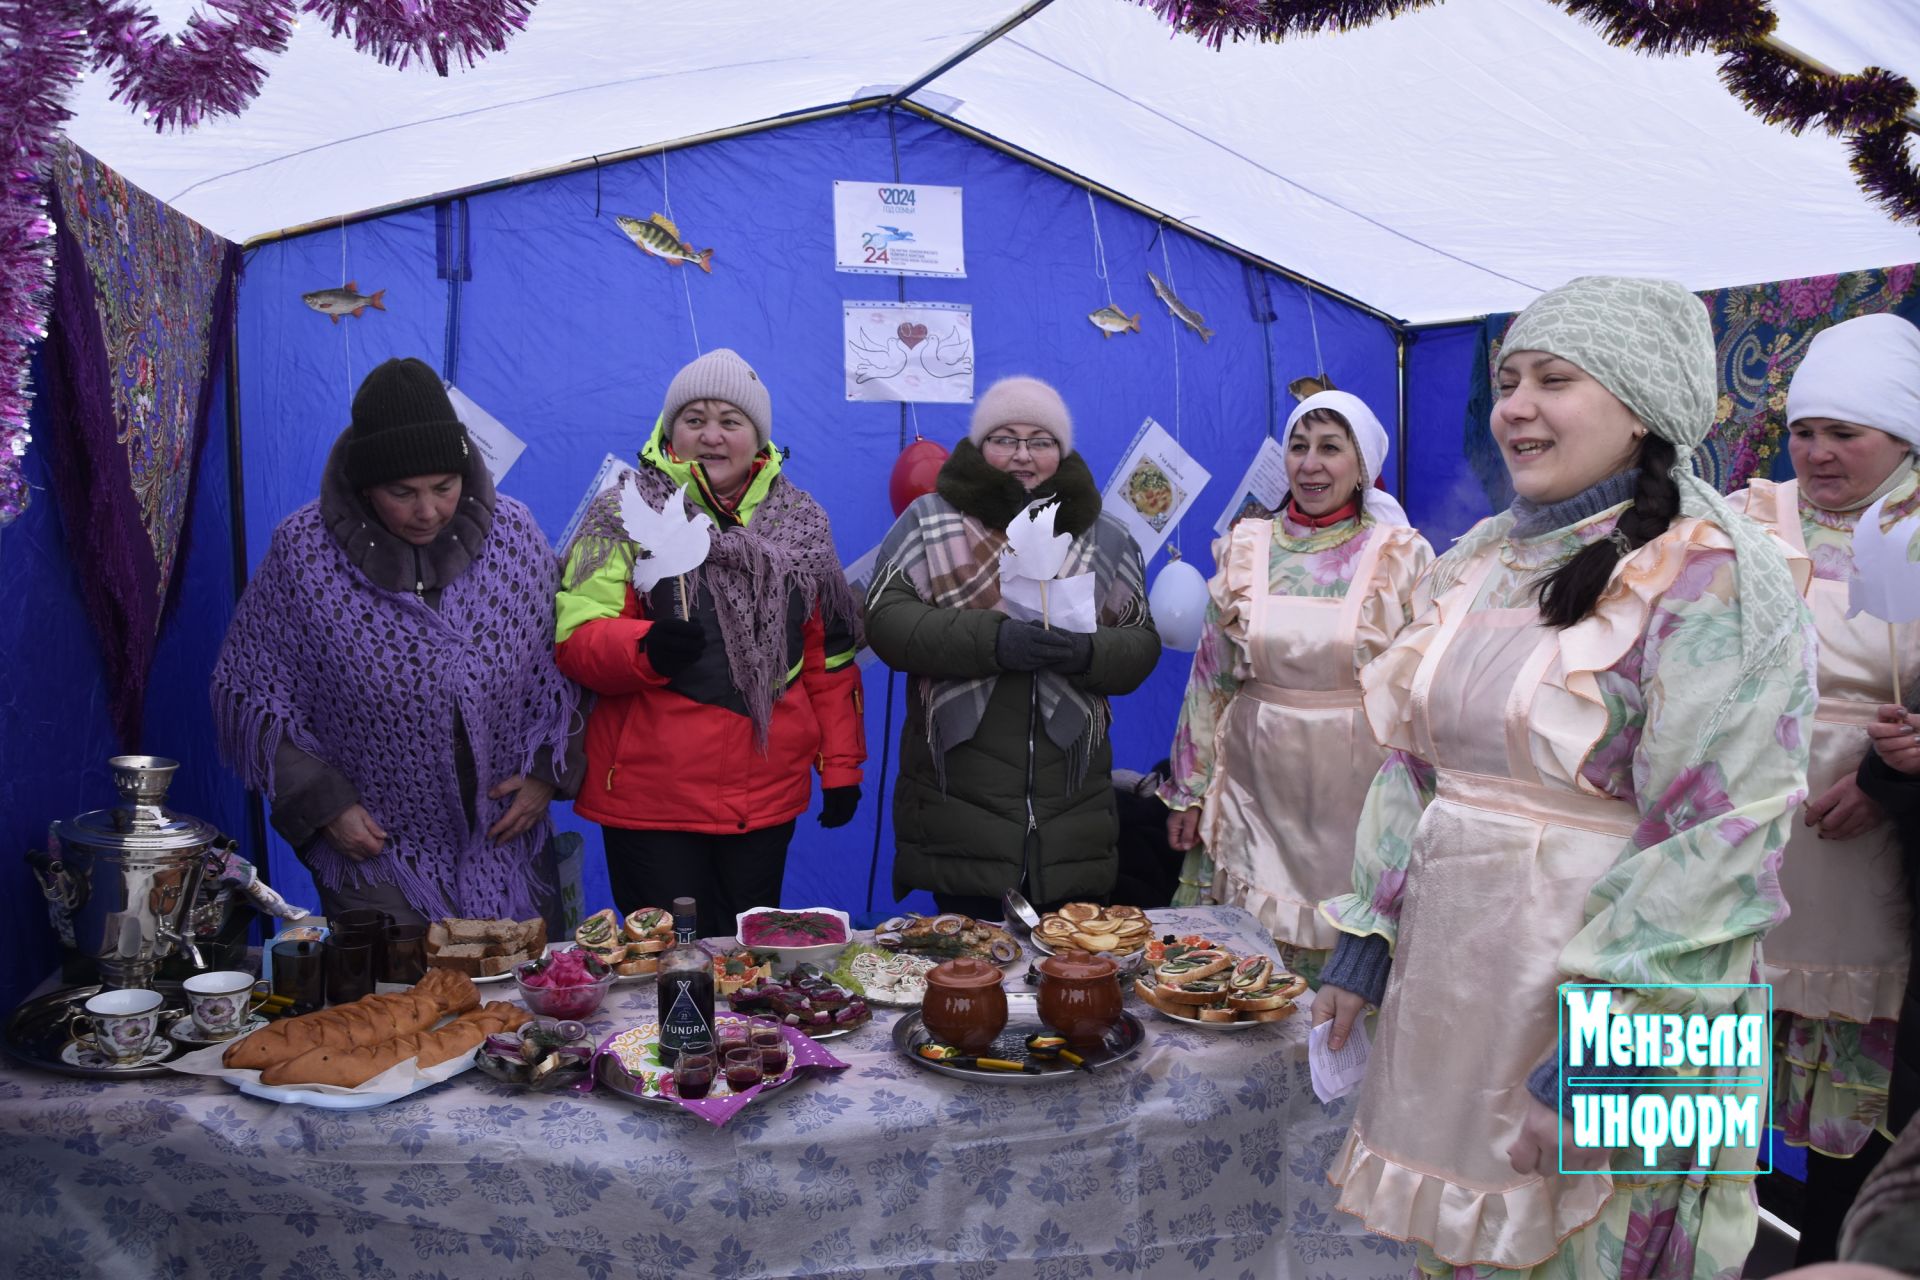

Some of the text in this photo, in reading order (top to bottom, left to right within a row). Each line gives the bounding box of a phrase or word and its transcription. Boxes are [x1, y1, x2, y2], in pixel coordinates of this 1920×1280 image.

[884, 188, 916, 206] 2024
[864, 246, 890, 264] 24
[665, 1024, 707, 1035] TUNDRA
